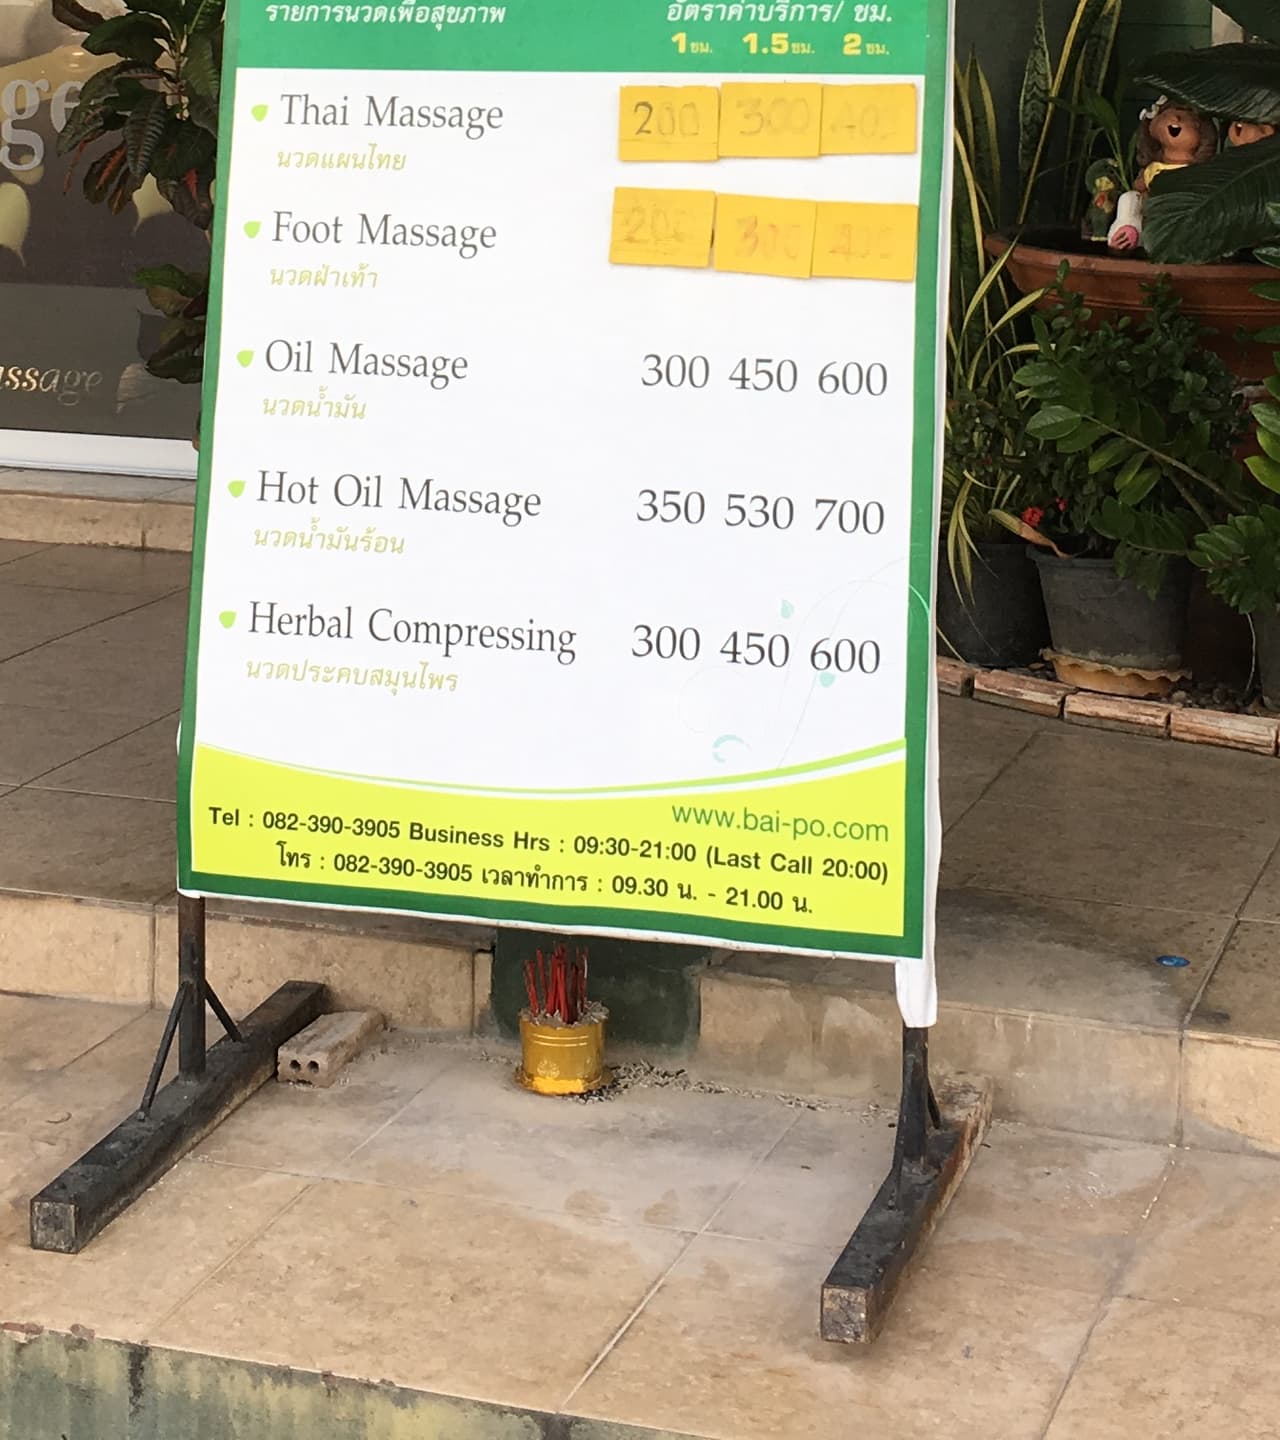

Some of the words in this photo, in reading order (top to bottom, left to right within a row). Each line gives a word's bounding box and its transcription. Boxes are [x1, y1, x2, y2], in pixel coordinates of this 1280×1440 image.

[853, 2, 893, 23] ชม.
[671, 32, 687, 54] 1
[742, 32, 789, 54] 1.5
[842, 33, 862, 55] 2
[281, 94, 351, 127] Thai
[363, 95, 504, 140] Massage
[633, 101, 700, 137] 200
[276, 143, 407, 170] นวดแผนไทย
[272, 210, 344, 244] Foot
[357, 213, 498, 259] Massage
[270, 263, 378, 289] นวดฝ่าเท้า
[265, 339, 313, 373] Oil
[328, 342, 469, 390] Massage
[641, 353, 710, 389] 300
[728, 357, 798, 392] 450
[817, 360, 888, 396] 600
[262, 386, 367, 420] นวดน้ำมัน
[256, 470, 319, 505] Hot
[333, 473, 383, 508] Oil
[398, 477, 542, 527] Massage
[636, 489, 706, 524] 350
[724, 493, 794, 530] 530
[814, 498, 885, 535] 700
[254, 517, 405, 554] นวดน้ำมันร้อน
[248, 600, 353, 639] Herbal
[367, 607, 577, 666] Compressing
[631, 624, 701, 661] 300
[720, 630, 790, 668] 450
[809, 637, 881, 674] 600
[246, 658, 459, 696] นวดประคบสมุนไพร
[671, 804, 889, 843] www.bai-po.com
[208, 806, 240, 826] Tel
[262, 810, 401, 839] 082-390-3905
[409, 822, 505, 848] Business
[513, 831, 551, 852] Hrs
[573, 835, 697, 862] 09:30-21:00
[706, 845, 761, 870] (Last
[770, 852, 813, 875] Call
[822, 858, 889, 886] 20:00)
[276, 840, 312, 869] โทร
[333, 853, 473, 882] 082-390-3905
[482, 864, 588, 893] เวลาทำการ
[612, 875, 669, 897] 09.30
[725, 886, 783, 910] 21.00
